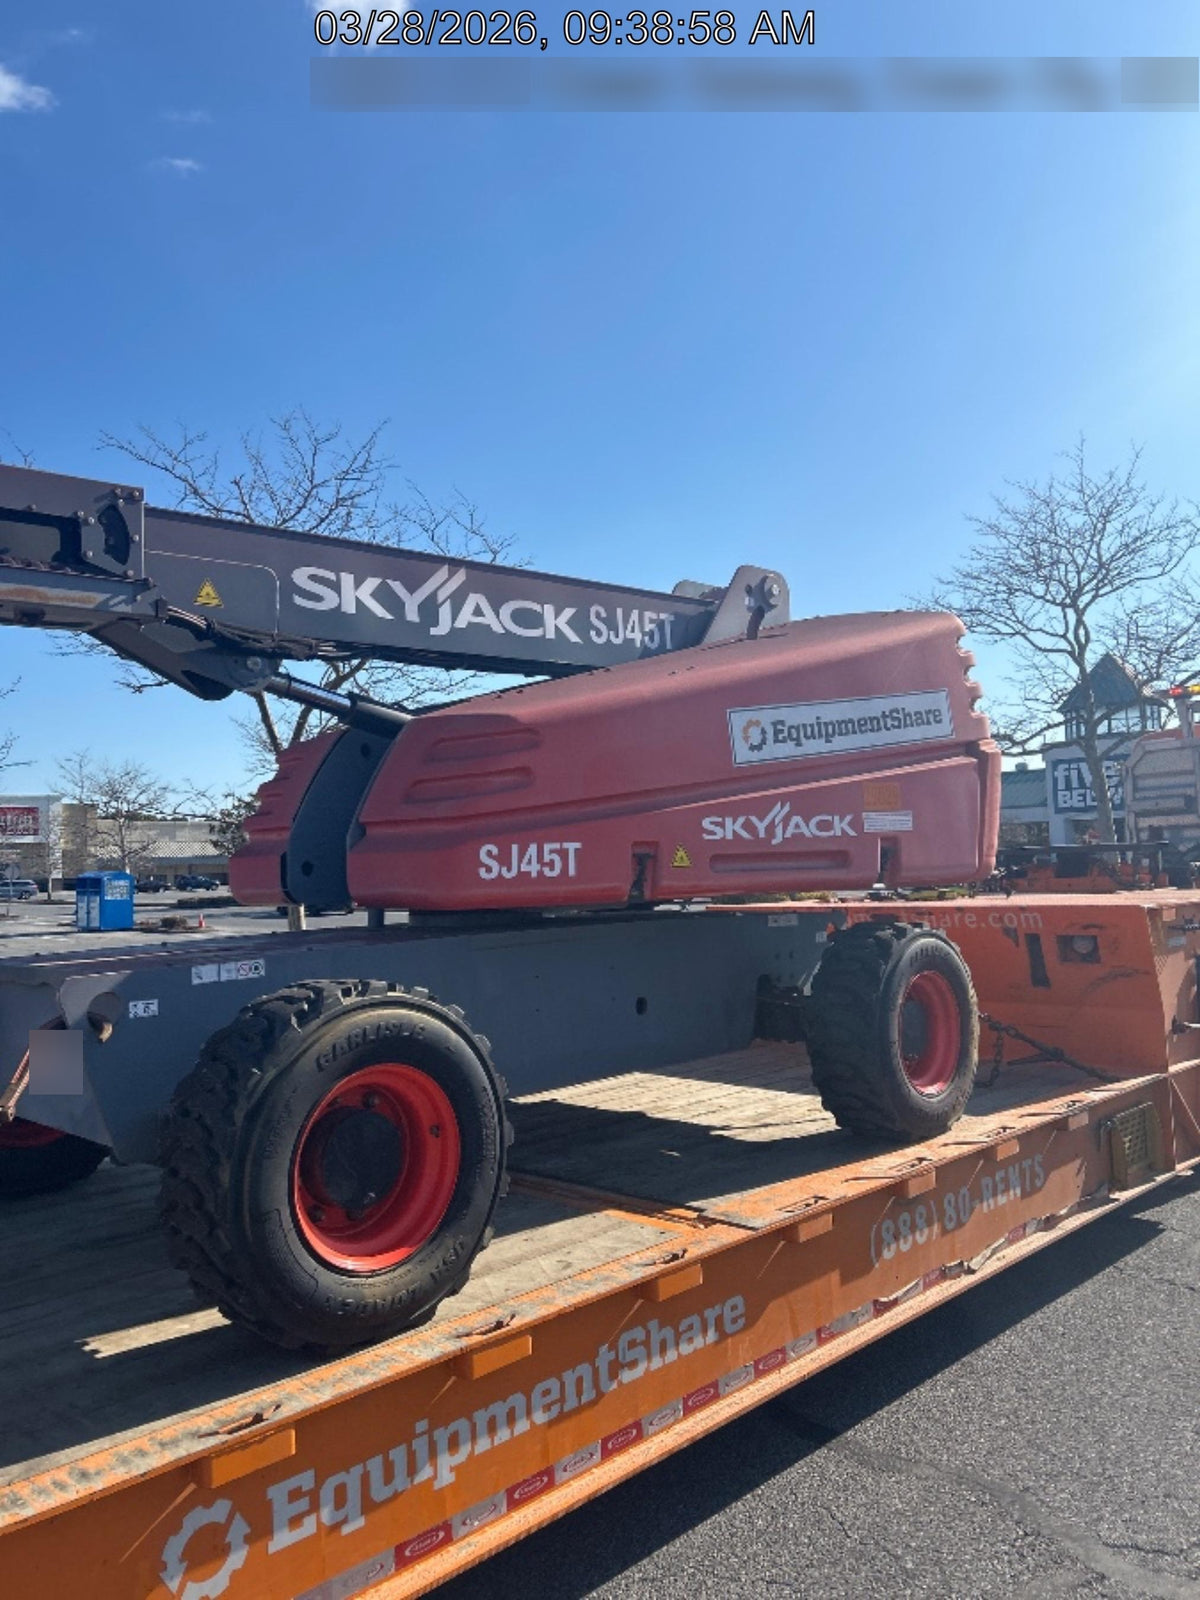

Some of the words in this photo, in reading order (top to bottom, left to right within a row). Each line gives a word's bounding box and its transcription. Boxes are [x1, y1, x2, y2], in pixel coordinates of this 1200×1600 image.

[291, 563, 583, 644] SKYJACK
[589, 603, 675, 651] SJ45T
[771, 704, 944, 747] EquipmentShare
[1057, 786, 1123, 808] BELW
[701, 800, 857, 846] SKYJACK
[479, 842, 582, 880] SJ45T
[870, 1201, 938, 1268] (888)
[266, 1296, 747, 1556] EquipmentShare
